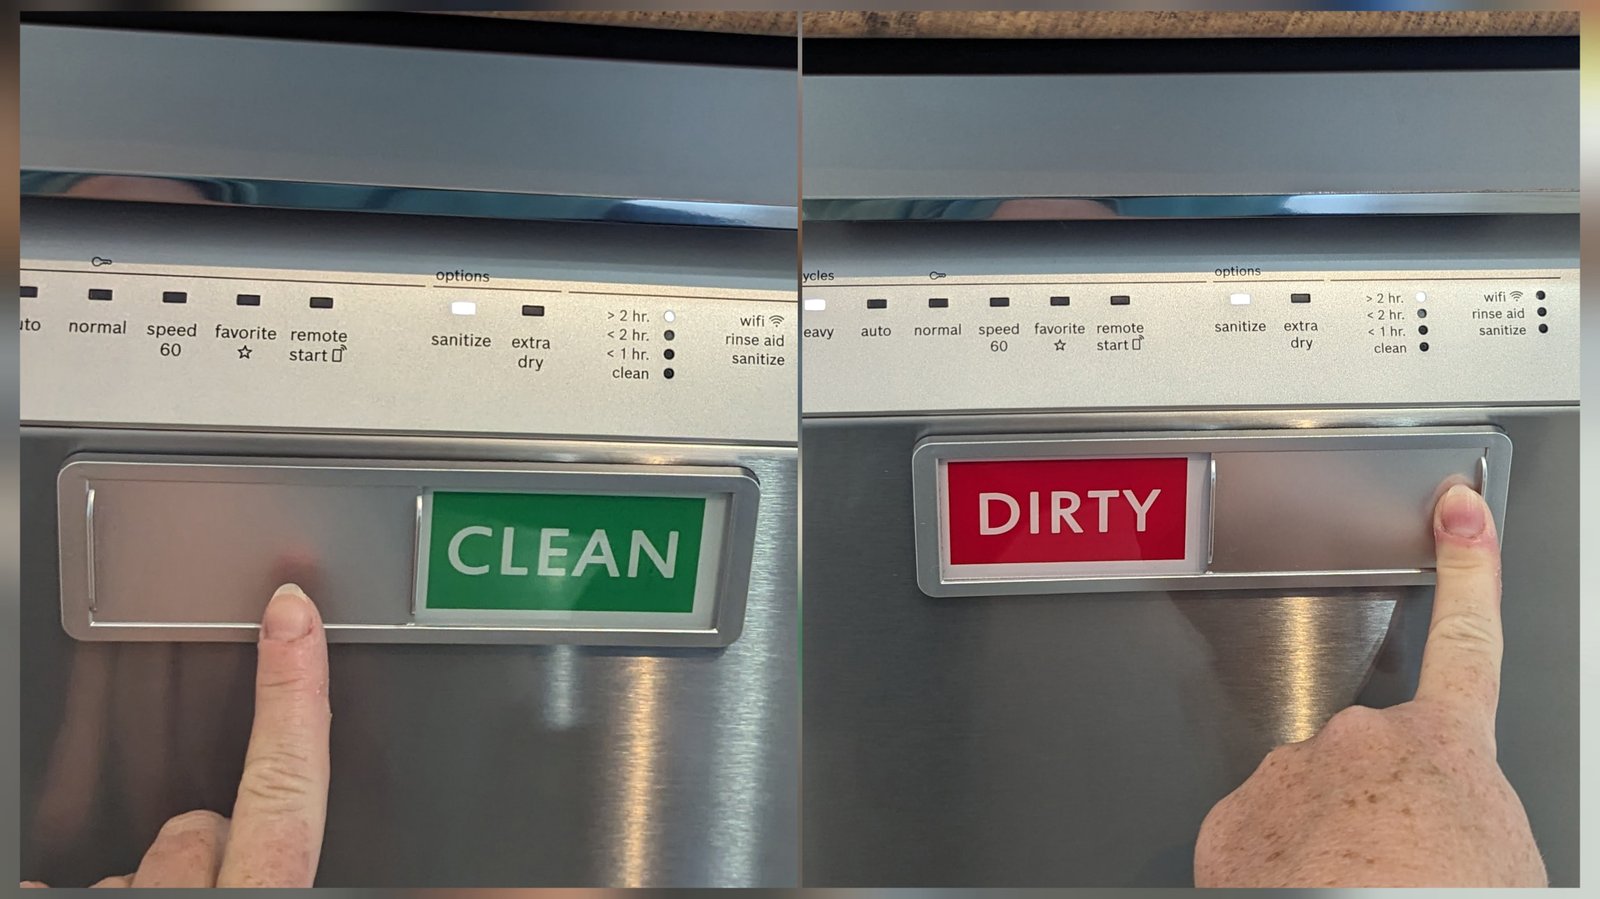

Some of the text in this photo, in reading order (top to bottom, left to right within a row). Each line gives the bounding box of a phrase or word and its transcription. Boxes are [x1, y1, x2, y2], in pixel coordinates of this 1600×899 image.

[434, 268, 492, 283] options
[801, 269, 835, 284] ycles
[1214, 263, 1261, 279] options
[1376, 292, 1384, 304] 2
[1388, 292, 1404, 304] hr.
[1483, 291, 1506, 303] wifi
[619, 309, 628, 322] 2
[632, 309, 650, 323] hr.
[739, 314, 765, 327] wifi
[1377, 309, 1385, 321] 2
[1389, 309, 1405, 321] hr.
[1472, 307, 1525, 320] rinse aid
[68, 320, 127, 335] normal
[146, 323, 197, 341] speed
[215, 323, 277, 341] favorite
[860, 325, 892, 337] auto
[914, 323, 962, 336] normal
[978, 323, 1020, 340] speed
[1034, 322, 1086, 335] favorite
[1096, 322, 1145, 335] remote
[1214, 320, 1267, 333] sanitize
[1283, 320, 1319, 332] extra
[1380, 326, 1385, 337] 1
[1390, 325, 1406, 337] hr.
[1479, 324, 1527, 336] sanitize
[290, 329, 348, 343] remote
[431, 333, 492, 348] sanitize
[619, 328, 628, 341] 2
[632, 328, 650, 342] hr.
[725, 332, 785, 347] rinse aid
[803, 328, 834, 340] eavy
[160, 342, 182, 357] 60
[511, 336, 551, 350] extra
[990, 340, 1009, 353] 60
[1096, 339, 1129, 351] start
[1290, 336, 1313, 351] dry
[1374, 342, 1407, 354] clean
[289, 348, 328, 362] start
[620, 347, 626, 360] 1
[632, 347, 649, 361] hr.
[732, 352, 785, 366] sanitize
[517, 354, 544, 372] dry
[612, 366, 649, 380] clean
[979, 489, 1162, 535] DIRTY
[448, 525, 680, 579] CLEAN
